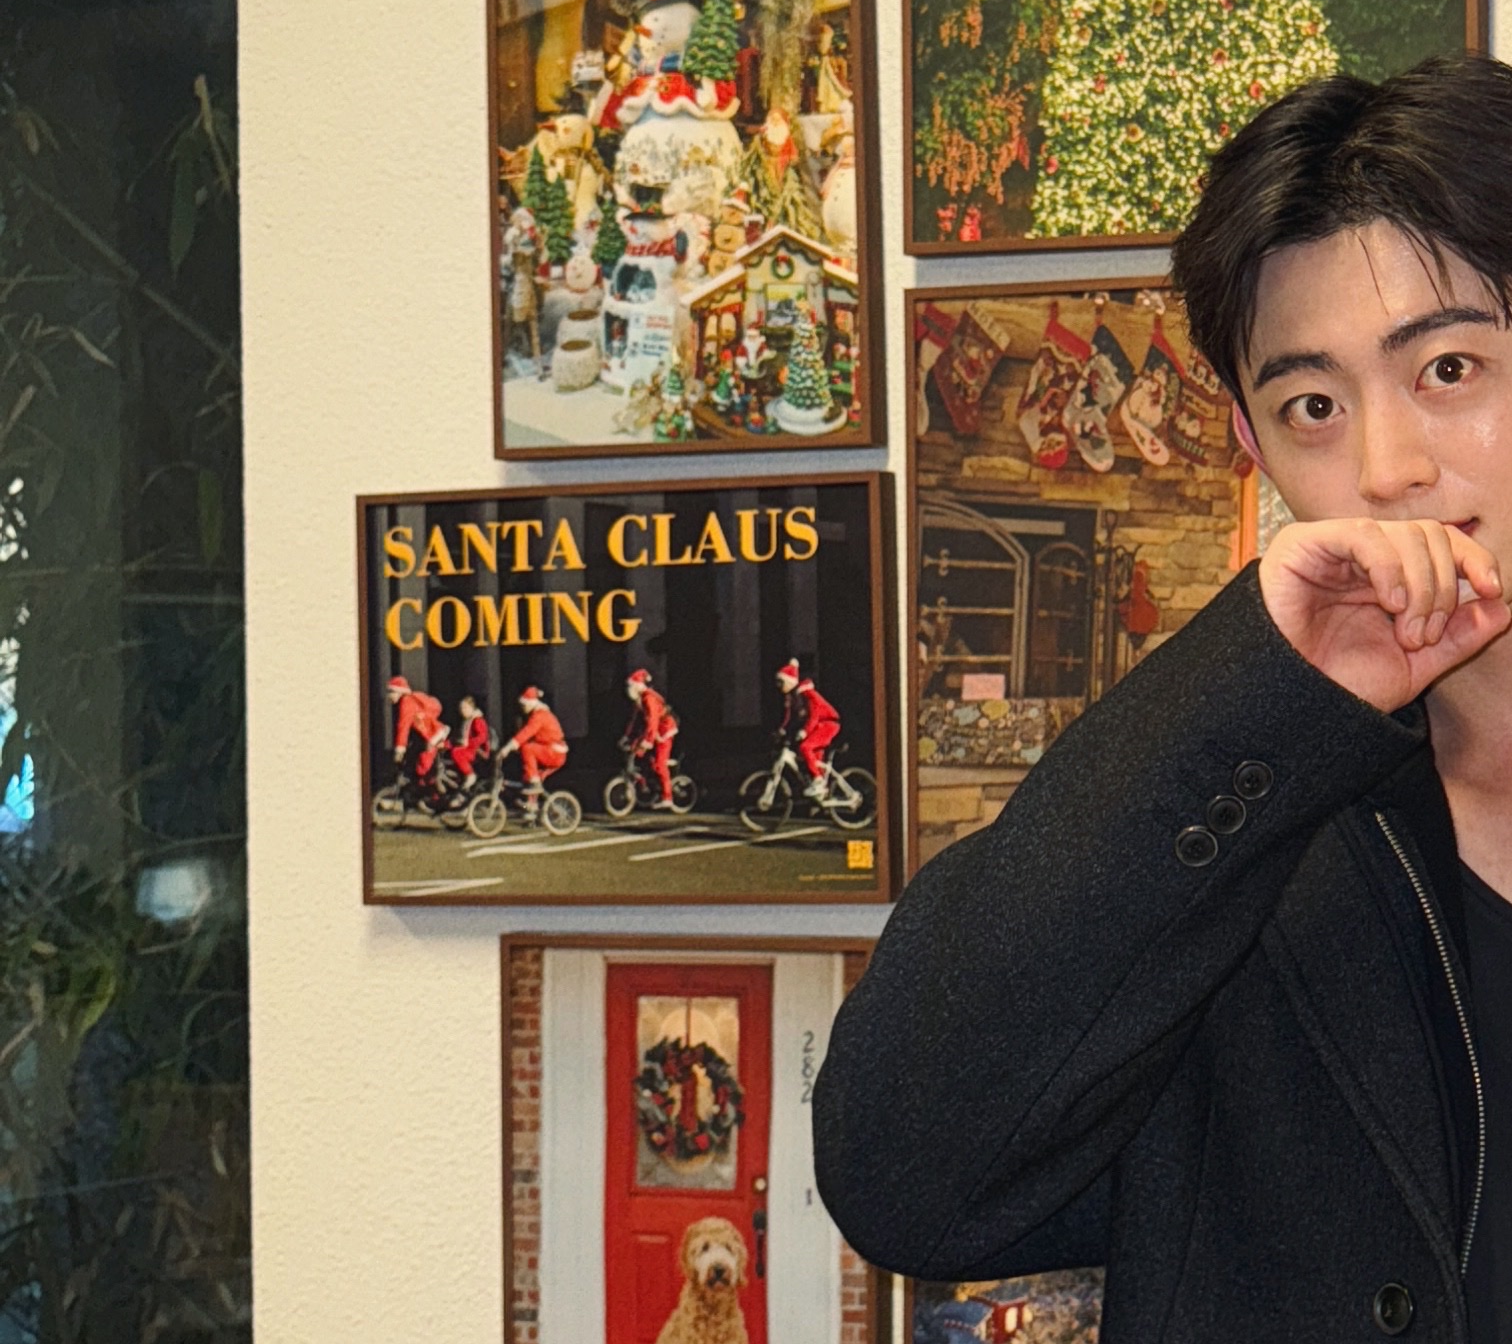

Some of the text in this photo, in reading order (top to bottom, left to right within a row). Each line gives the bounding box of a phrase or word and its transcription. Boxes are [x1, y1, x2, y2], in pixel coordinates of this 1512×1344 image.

[383, 507, 820, 579] SANTA CLAUS
[384, 588, 643, 651] COMING
